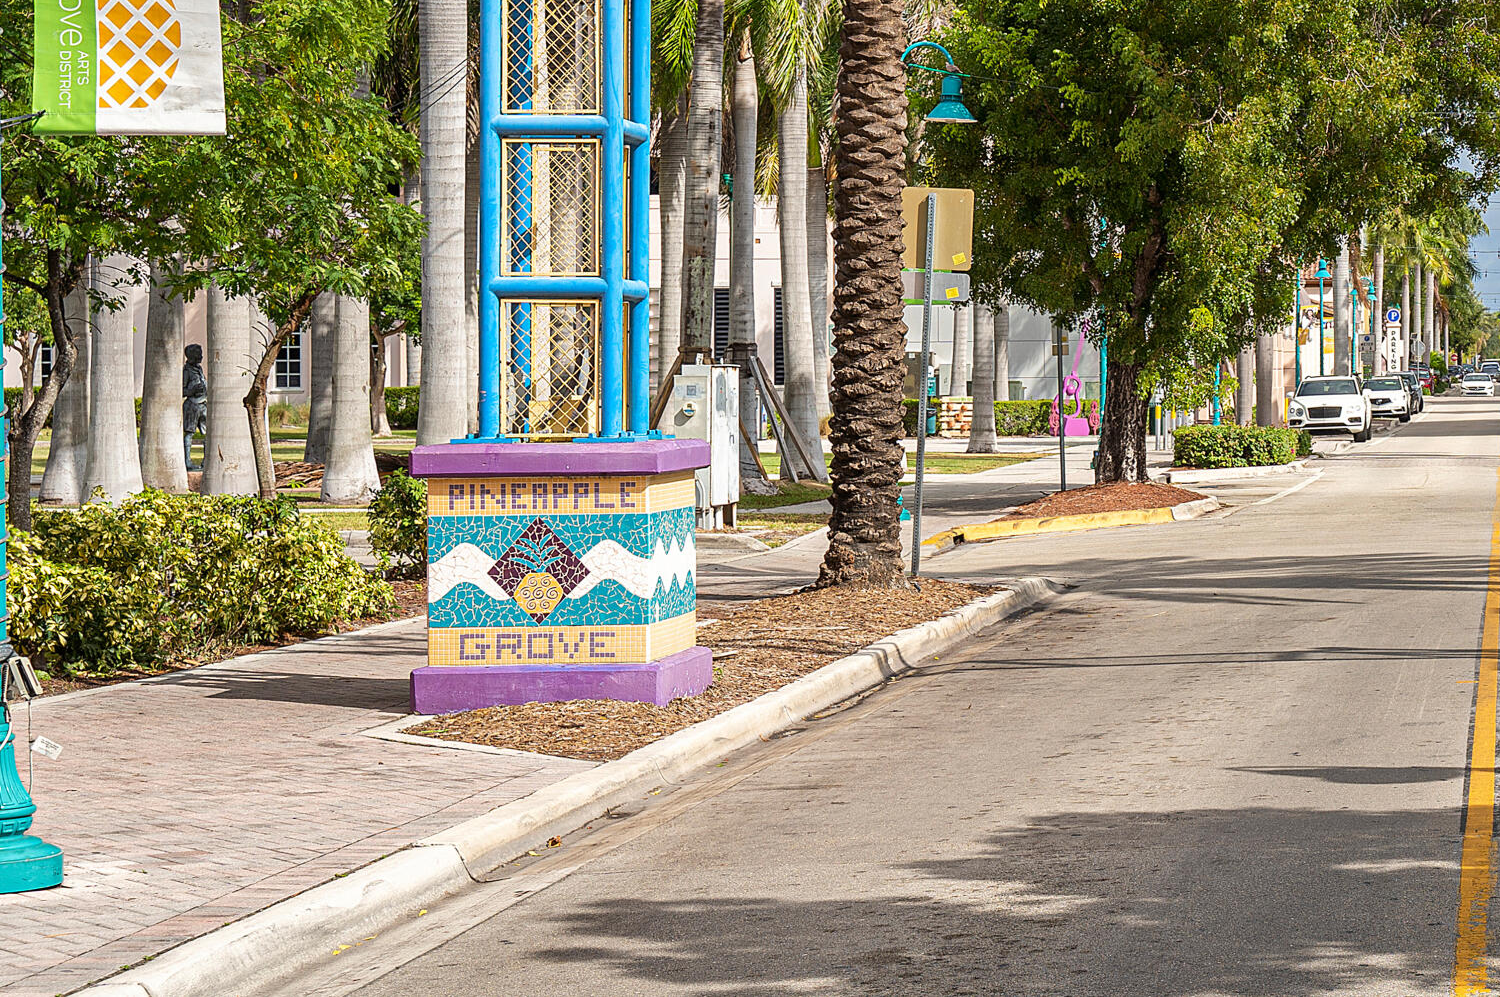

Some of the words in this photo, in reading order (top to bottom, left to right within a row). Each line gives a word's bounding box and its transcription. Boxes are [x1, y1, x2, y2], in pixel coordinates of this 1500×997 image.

[59, 51, 71, 109] DISTRICT
[77, 50, 89, 85] ARTS
[1391, 312, 1398, 320] P
[449, 482, 636, 510] PINEAPPLE
[460, 632, 615, 660] GROVE
